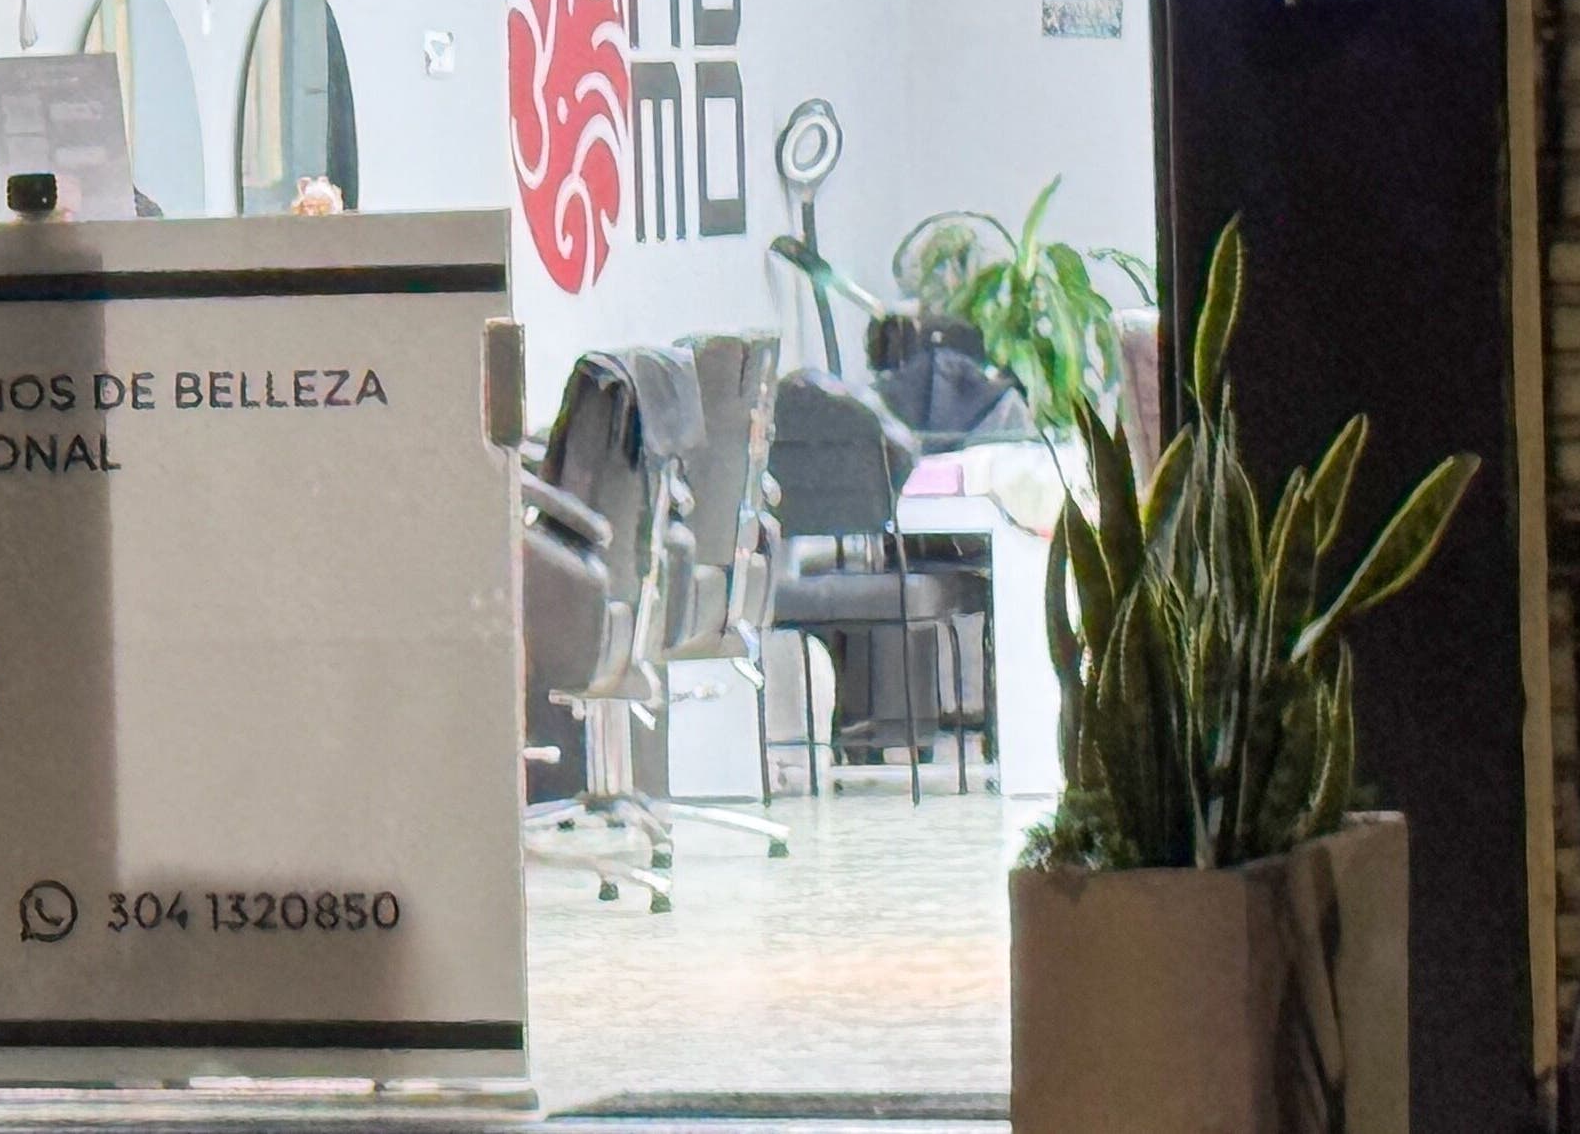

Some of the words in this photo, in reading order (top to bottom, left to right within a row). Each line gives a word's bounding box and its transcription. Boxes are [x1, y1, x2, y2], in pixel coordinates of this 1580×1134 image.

[92, 371, 157, 411] DE
[174, 368, 388, 410] BELLEZA
[108, 890, 189, 931] 304
[205, 889, 400, 931] 1320850
